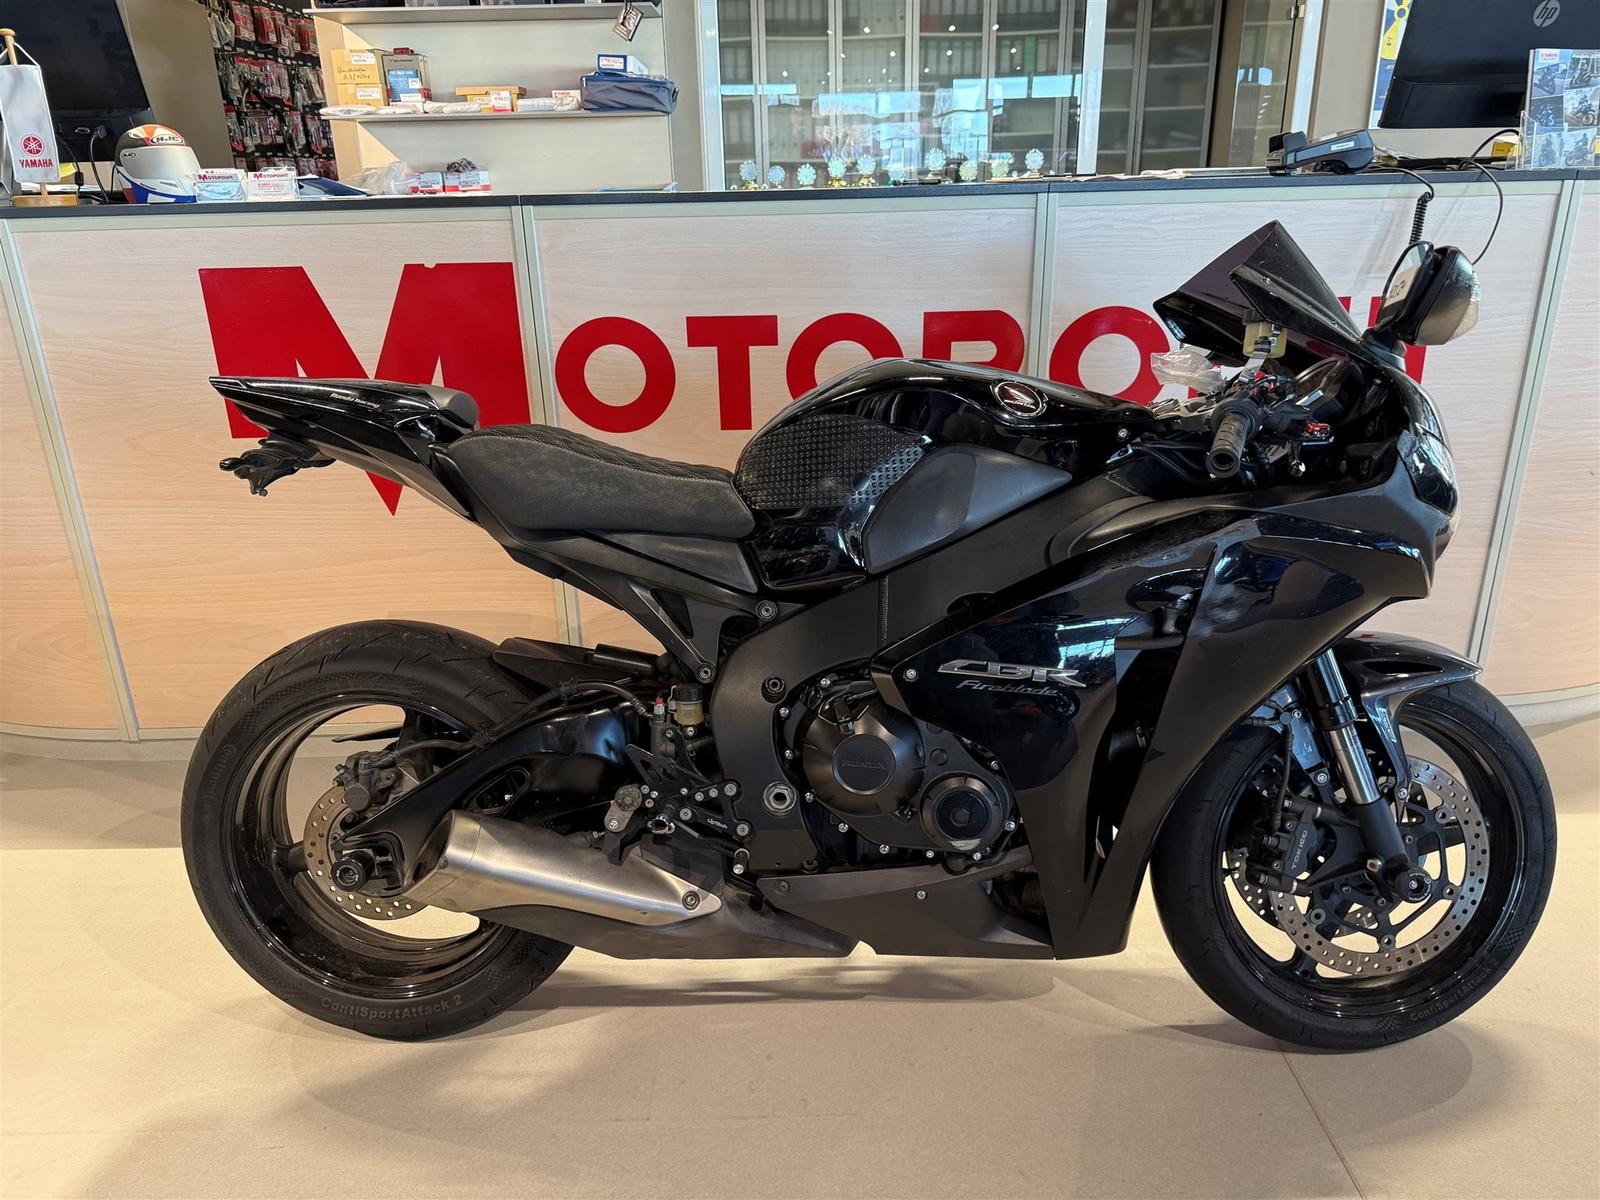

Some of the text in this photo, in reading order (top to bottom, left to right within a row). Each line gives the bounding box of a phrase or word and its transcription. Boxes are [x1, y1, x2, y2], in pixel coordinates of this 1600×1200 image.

[1535, 0, 1558, 28] hp
[20, 158, 54, 169] YAMAHA
[937, 658, 1087, 688] CBR
[956, 679, 1059, 697] Fireblade
[1290, 830, 1308, 870] TOKICO
[1409, 957, 1499, 1022] ContiSportAttack 2
[320, 994, 464, 1021] ContiSportAttack 2
